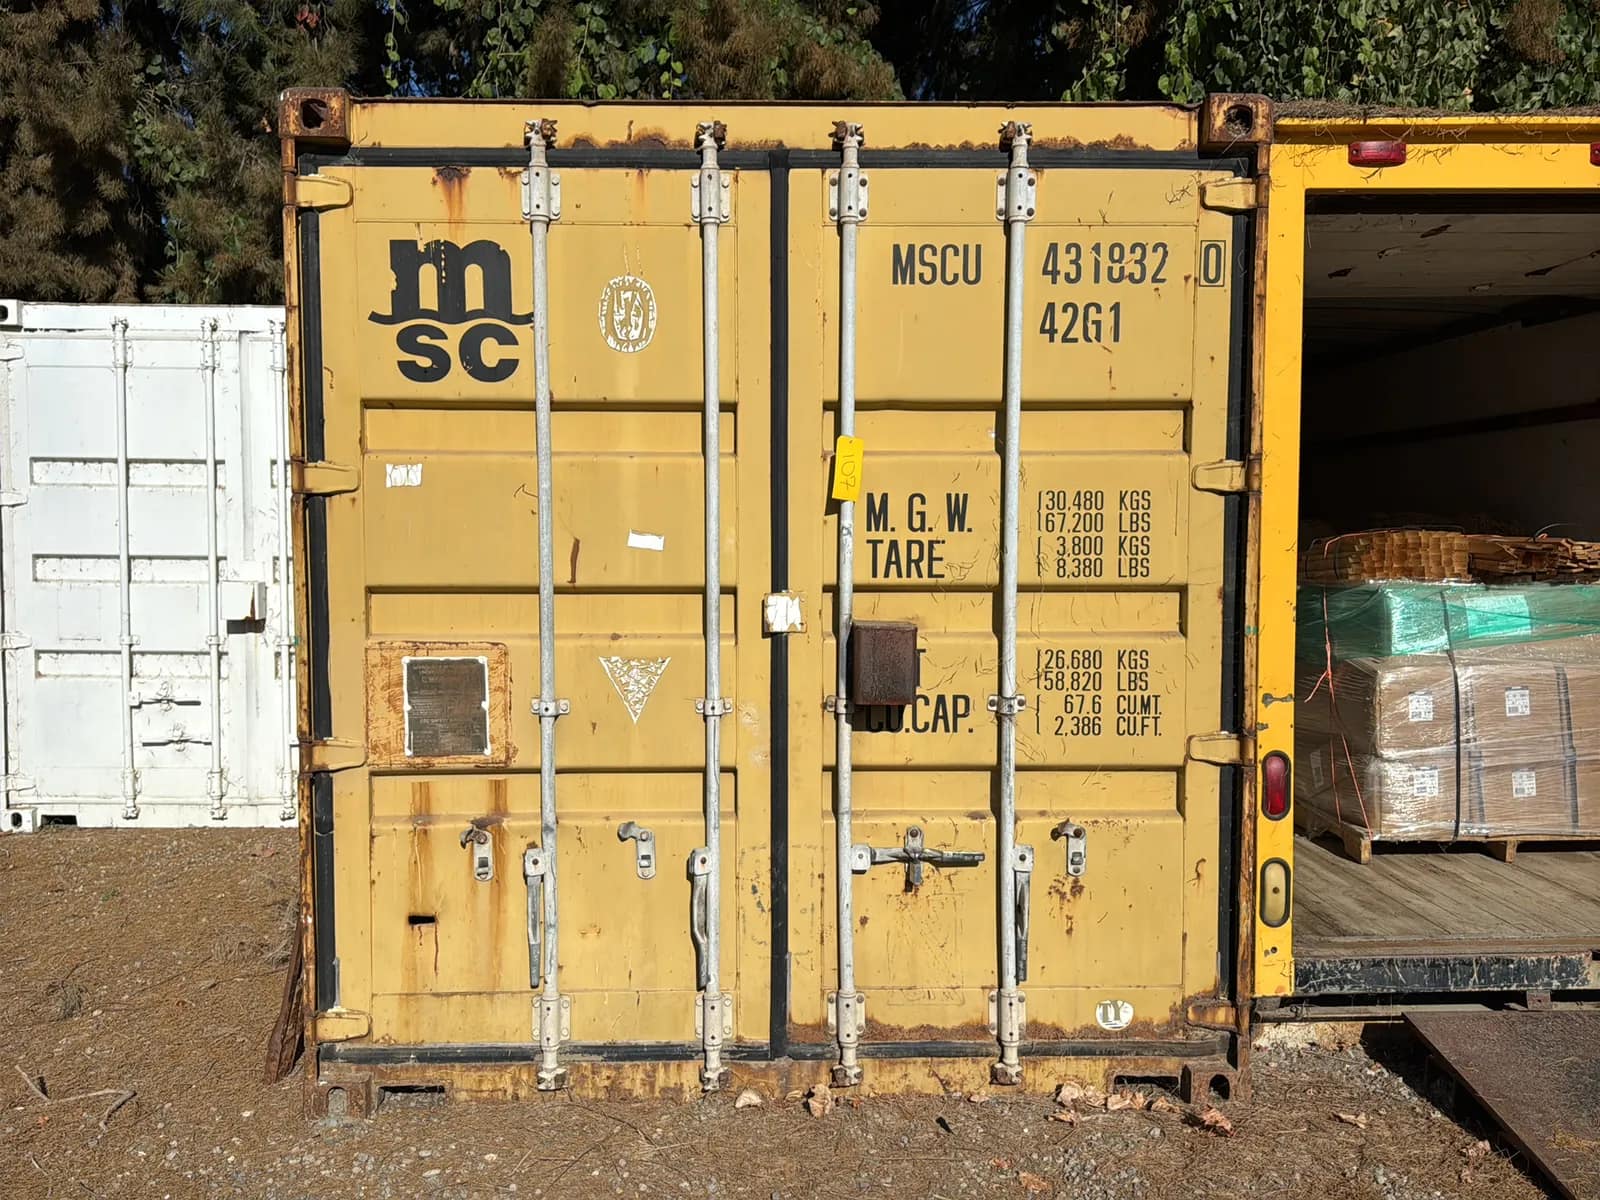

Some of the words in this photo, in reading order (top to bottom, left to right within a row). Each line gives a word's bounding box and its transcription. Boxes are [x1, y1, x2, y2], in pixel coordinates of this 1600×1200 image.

[892, 243, 982, 286] MSCU
[1041, 241, 1169, 285] 431832
[1202, 242, 1222, 285] 0
[1039, 301, 1121, 343] 42G1
[1119, 490, 1152, 511] KGS
[866, 492, 896, 533] M.
[907, 492, 934, 533] G.
[946, 492, 973, 533] W.
[1118, 513, 1151, 533] LBS
[1056, 535, 1103, 557] 3,800
[1118, 535, 1151, 556] KGS
[866, 539, 945, 579] TARE
[1118, 557, 1150, 578] LBS
[1117, 649, 1149, 670] KGS
[1117, 671, 1149, 691] LBS
[1064, 694, 1101, 714] 67.6
[1054, 716, 1102, 738] 2,386
